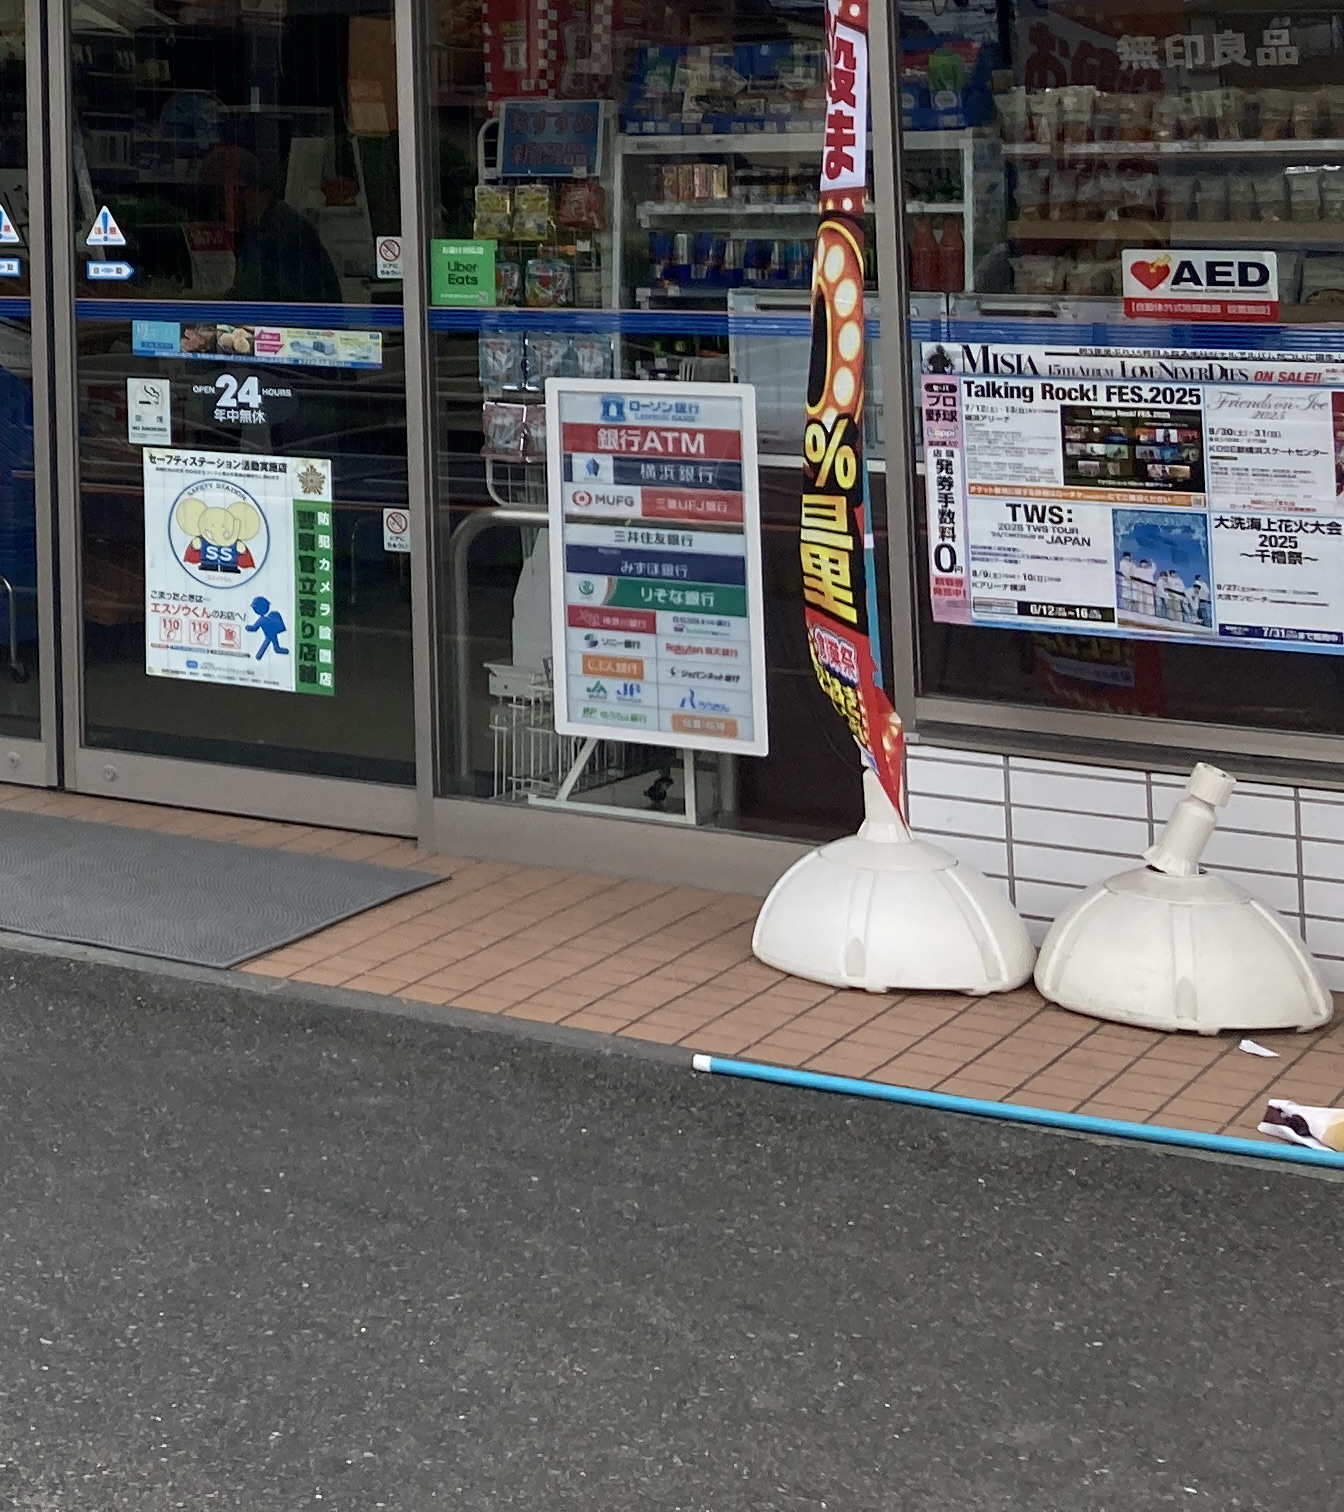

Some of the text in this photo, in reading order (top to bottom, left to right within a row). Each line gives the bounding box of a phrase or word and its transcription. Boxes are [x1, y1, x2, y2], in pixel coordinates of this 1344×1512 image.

[1116, 29, 1299, 71] 無印良品
[447, 260, 478, 272] Uber
[1170, 260, 1270, 287] AED
[447, 273, 479, 286] Eats
[961, 343, 1041, 376] MISIA
[1254, 371, 1275, 382] ON
[1277, 371, 1322, 383] SALE!!
[192, 374, 292, 408] OPEN 24 HOURS
[963, 380, 1201, 405] Talking Rock! FES.2025
[629, 400, 701, 415] ローソン銀行
[926, 395, 957, 408] プロ
[213, 409, 267, 424] 年中無休
[925, 409, 958, 423] 野球
[597, 427, 706, 456] 銀行ATM
[148, 453, 288, 474] セーフティステーション活動実施店
[640, 462, 715, 484] 横浜銀行
[595, 494, 635, 507] MUFG
[936, 458, 956, 543] 発券手数料
[1005, 502, 1073, 524] TWS:
[1213, 515, 1344, 536] 大洗海上花火大会
[614, 530, 694, 547] 三井住友銀行
[1045, 535, 1092, 547] JAPAN
[1258, 534, 1299, 549] 2025
[205, 546, 233, 562] SS
[620, 560, 689, 578] みずほ銀行
[640, 586, 715, 608] りそな銀行
[162, 619, 180, 631] 110
[665, 642, 703, 656] Rakuten
